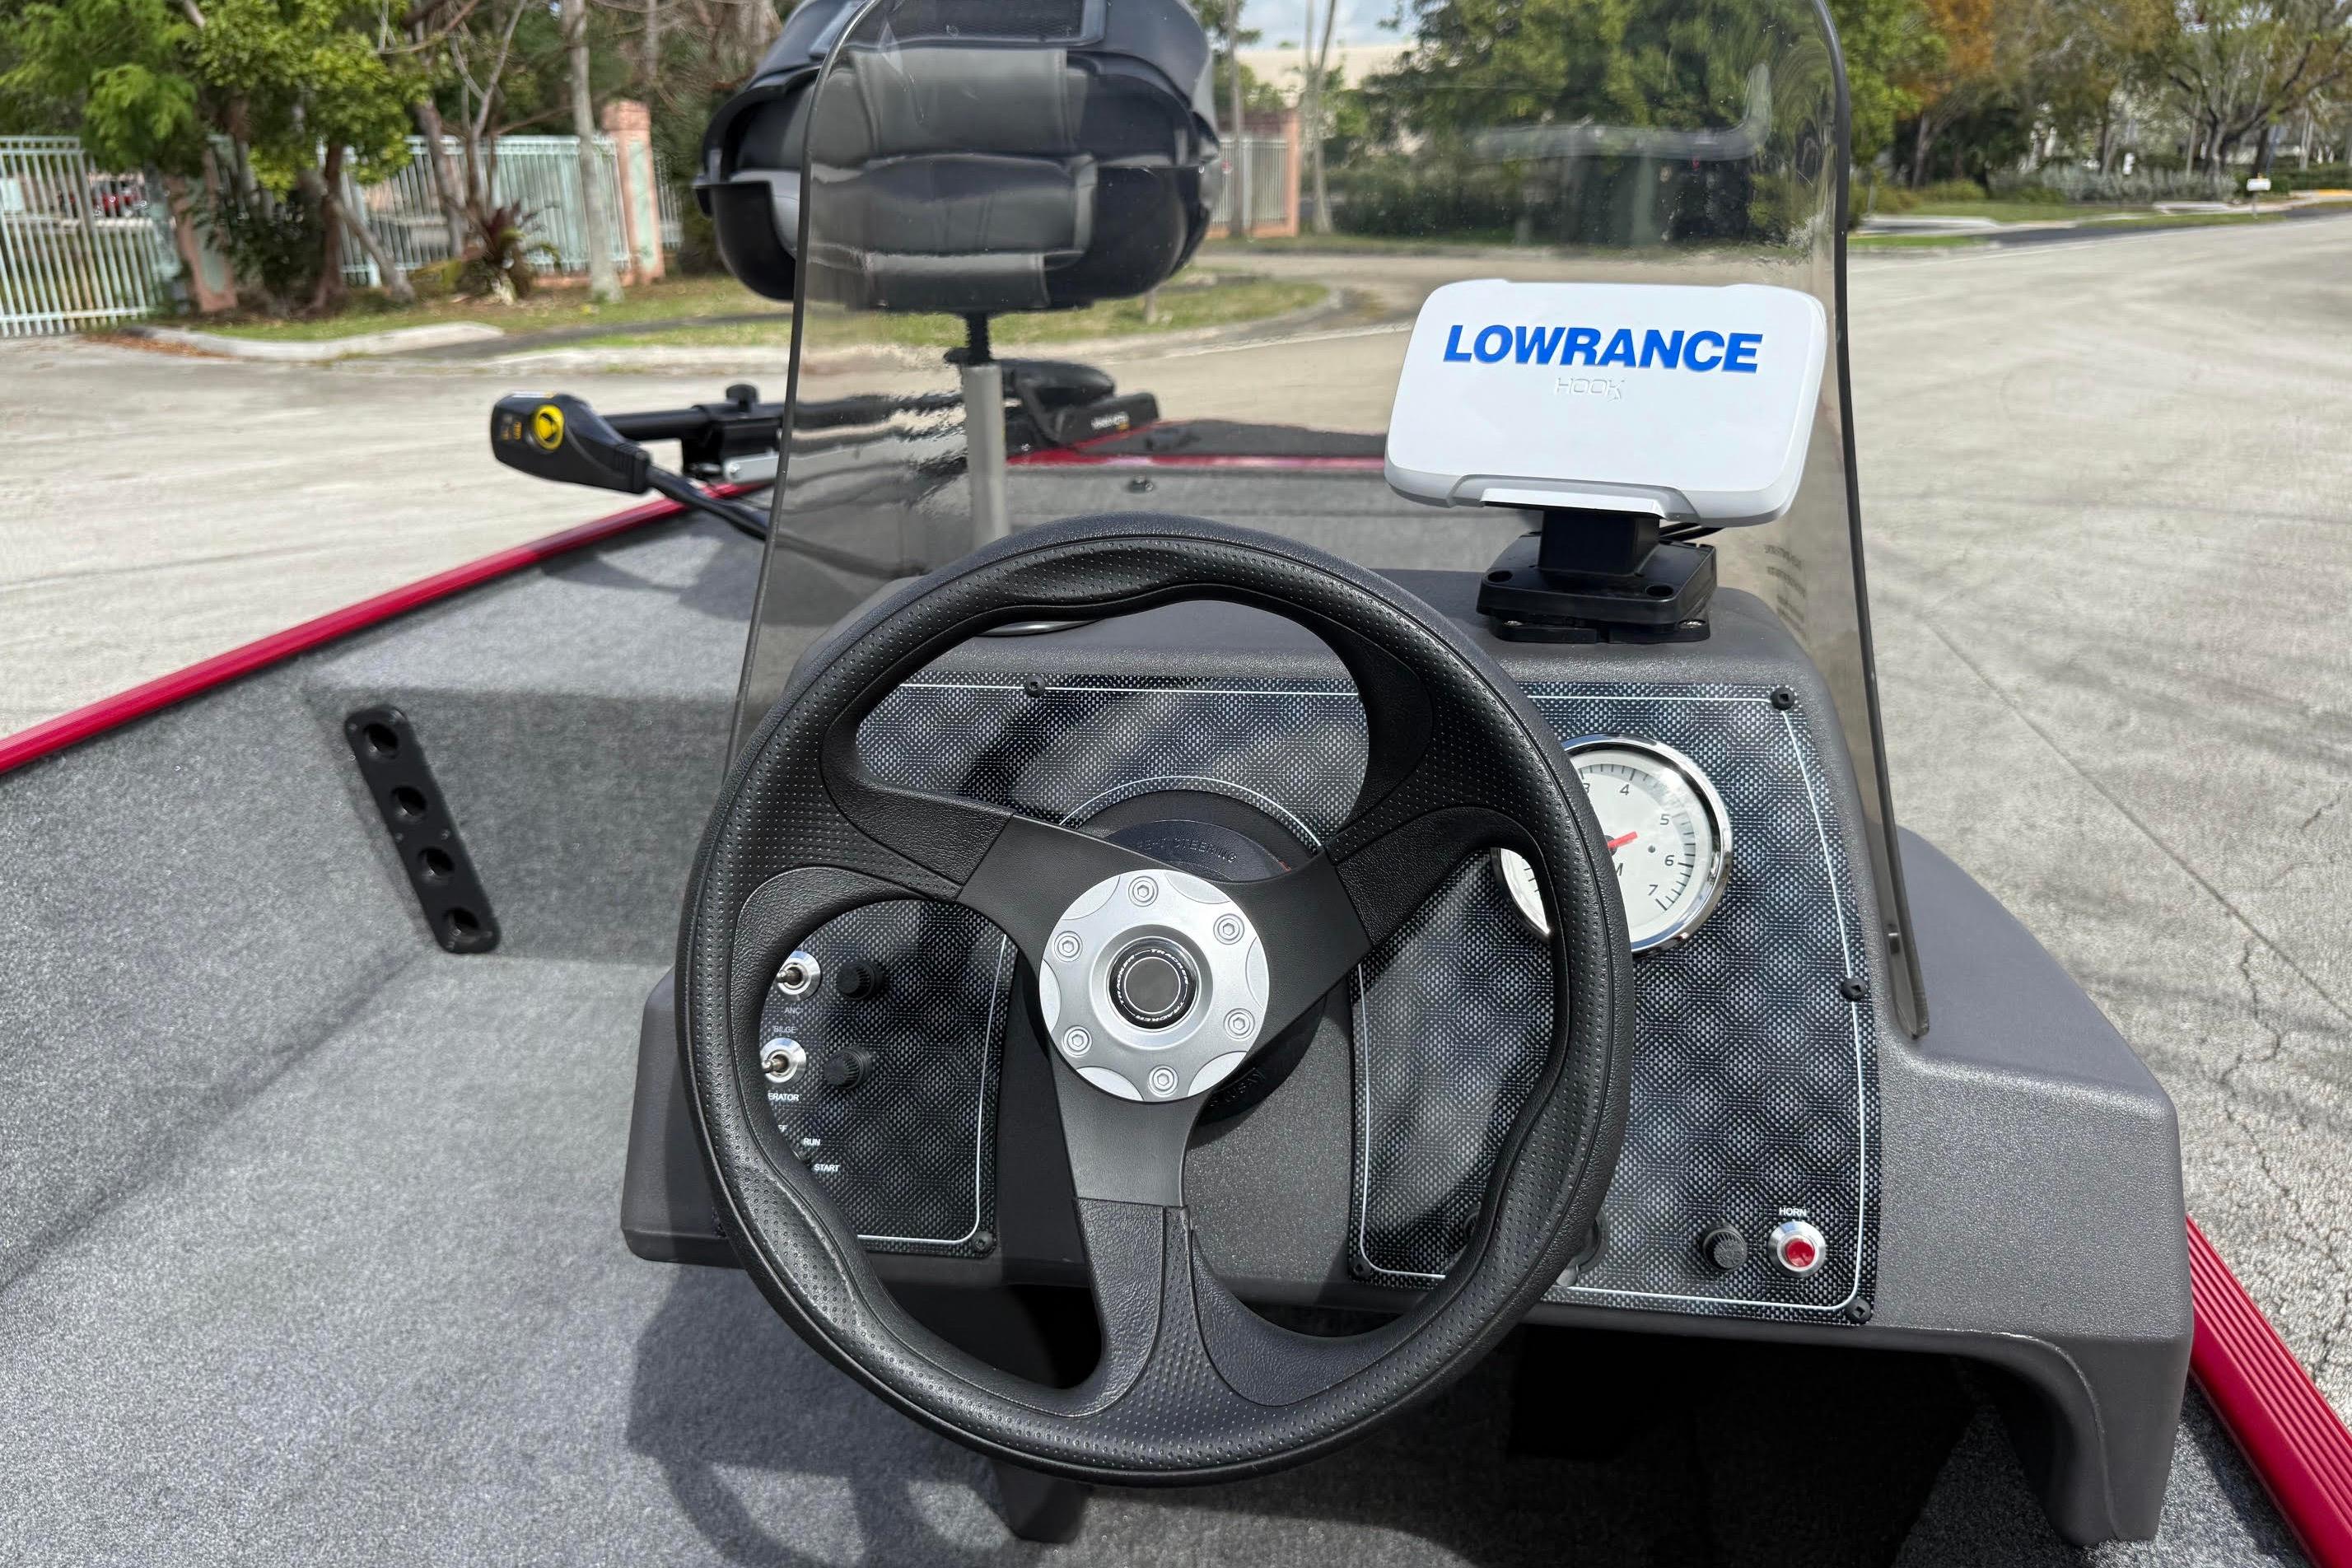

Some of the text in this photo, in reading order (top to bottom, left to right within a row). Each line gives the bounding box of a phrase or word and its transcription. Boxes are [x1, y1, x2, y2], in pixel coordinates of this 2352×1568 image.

[1443, 324, 1763, 373] LOWRANCE
[1620, 783, 1630, 796] 4
[1660, 814, 1670, 826] 5
[1664, 855, 1674, 866] 6
[1648, 884, 1659, 896] 7
[1150, 949, 1189, 985] TRACKER
[773, 1025, 797, 1034] BILGE
[767, 1092, 800, 1102] ERATOR
[802, 1137, 821, 1146] RUN
[813, 1164, 840, 1173] START
[1779, 1206, 1807, 1217] HORN
